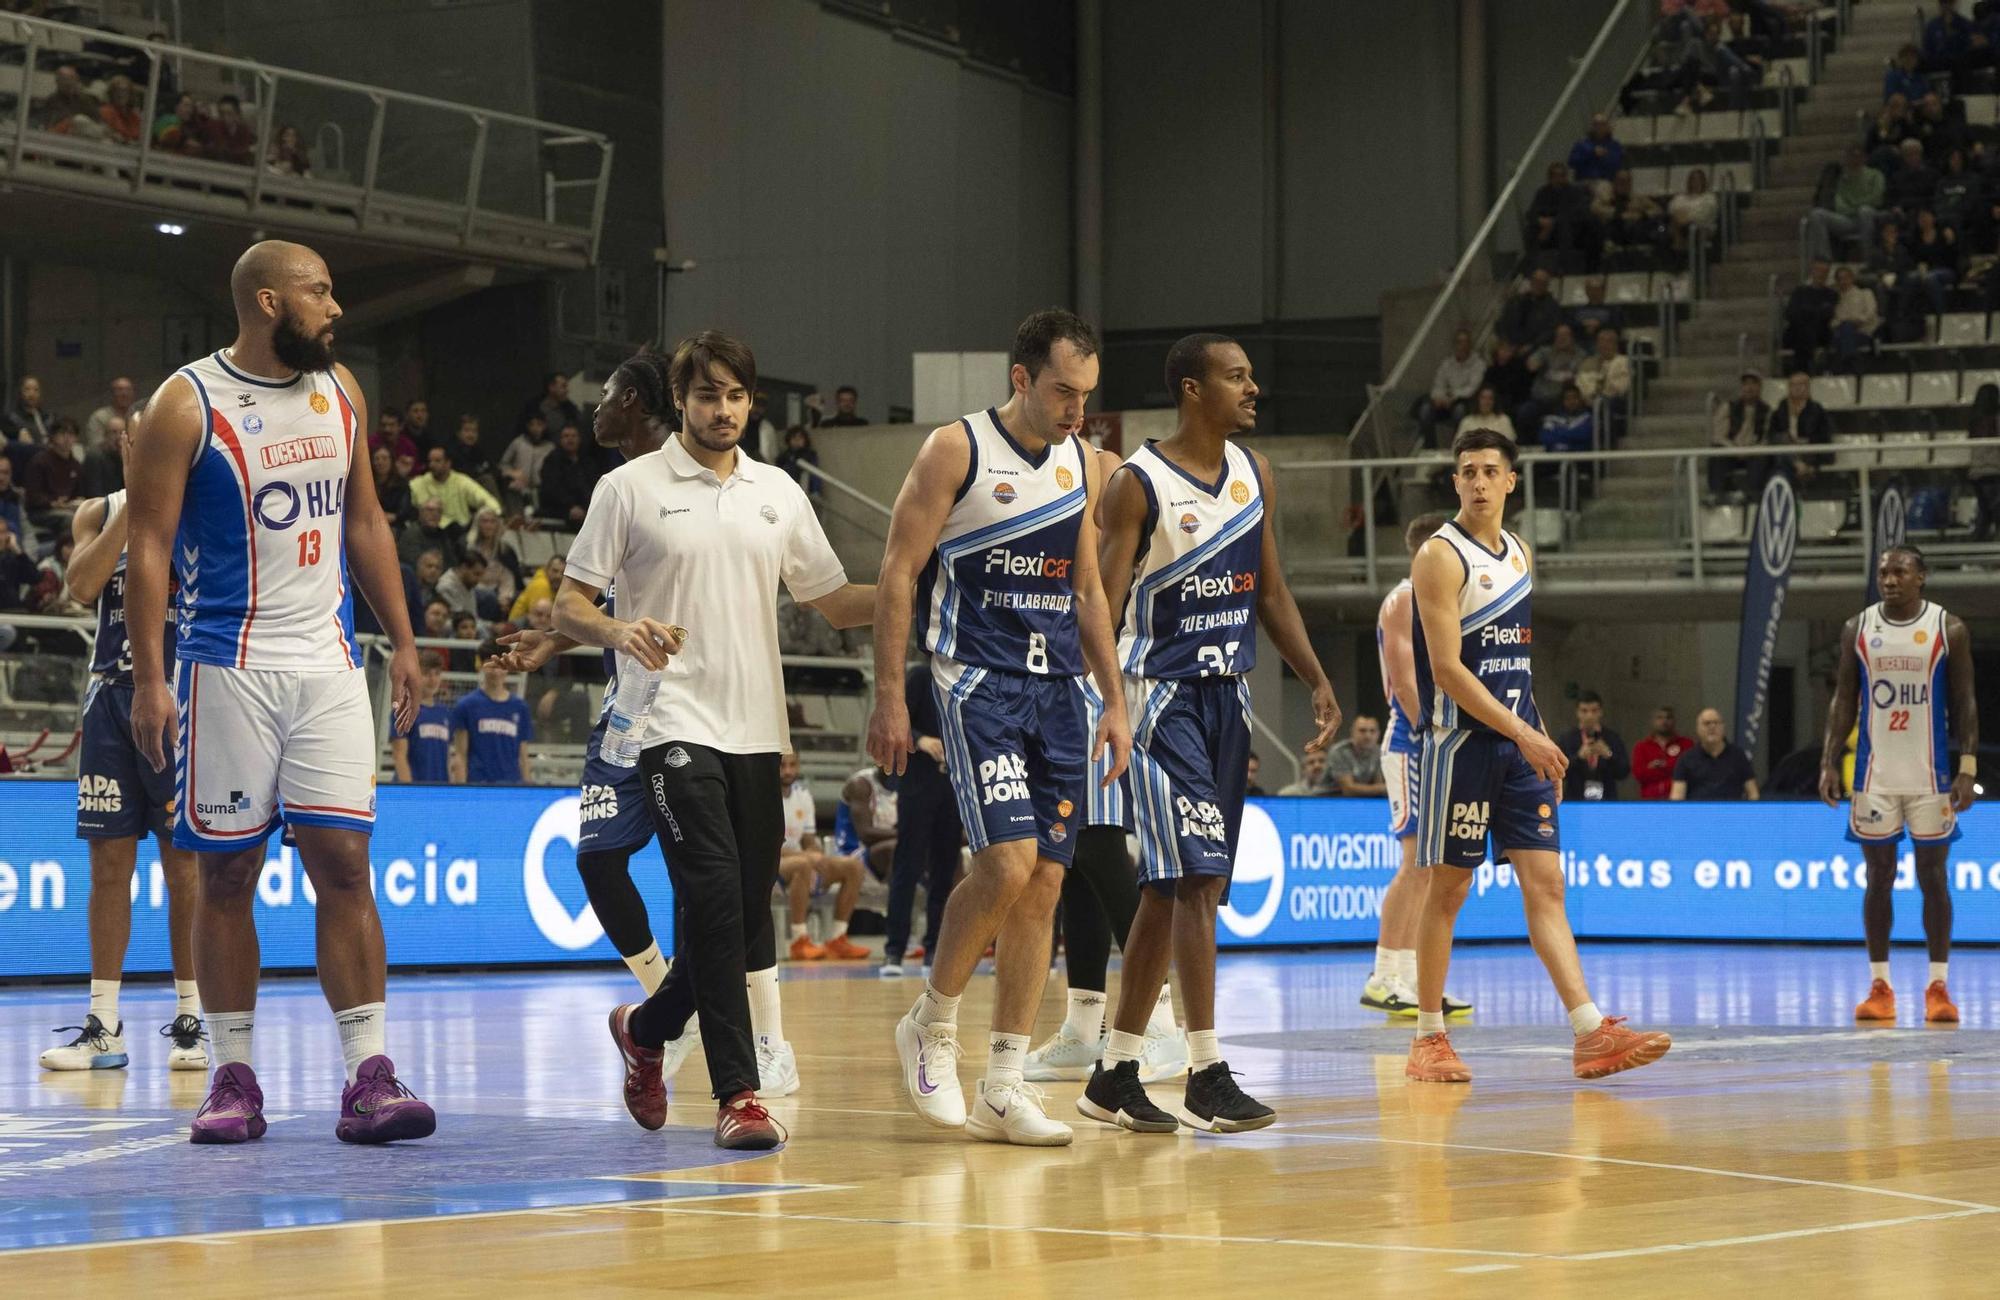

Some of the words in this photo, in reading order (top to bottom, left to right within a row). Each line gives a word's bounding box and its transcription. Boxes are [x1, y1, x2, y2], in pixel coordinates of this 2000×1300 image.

[261, 437, 337, 469] LUCENTUM
[306, 478, 343, 518] HLA
[1170, 499, 1198, 507] Kromex
[297, 529, 321, 567] 13
[984, 548, 1072, 579] Flexicar
[1481, 623, 1533, 647] Flexica
[1026, 631, 1050, 674] 8
[1507, 689, 1521, 717] 7
[1900, 683, 1928, 705] HLA
[1889, 709, 1909, 731] 22
[79, 774, 121, 796] APA
[984, 781, 1030, 805] JOH
[78, 797, 122, 813] OHNS
[196, 803, 237, 814] suma
[580, 801, 619, 823] HNS
[1449, 823, 1487, 841] JOH
[1694, 859, 1752, 889] en
[1290, 885, 1389, 920] ORTODON
